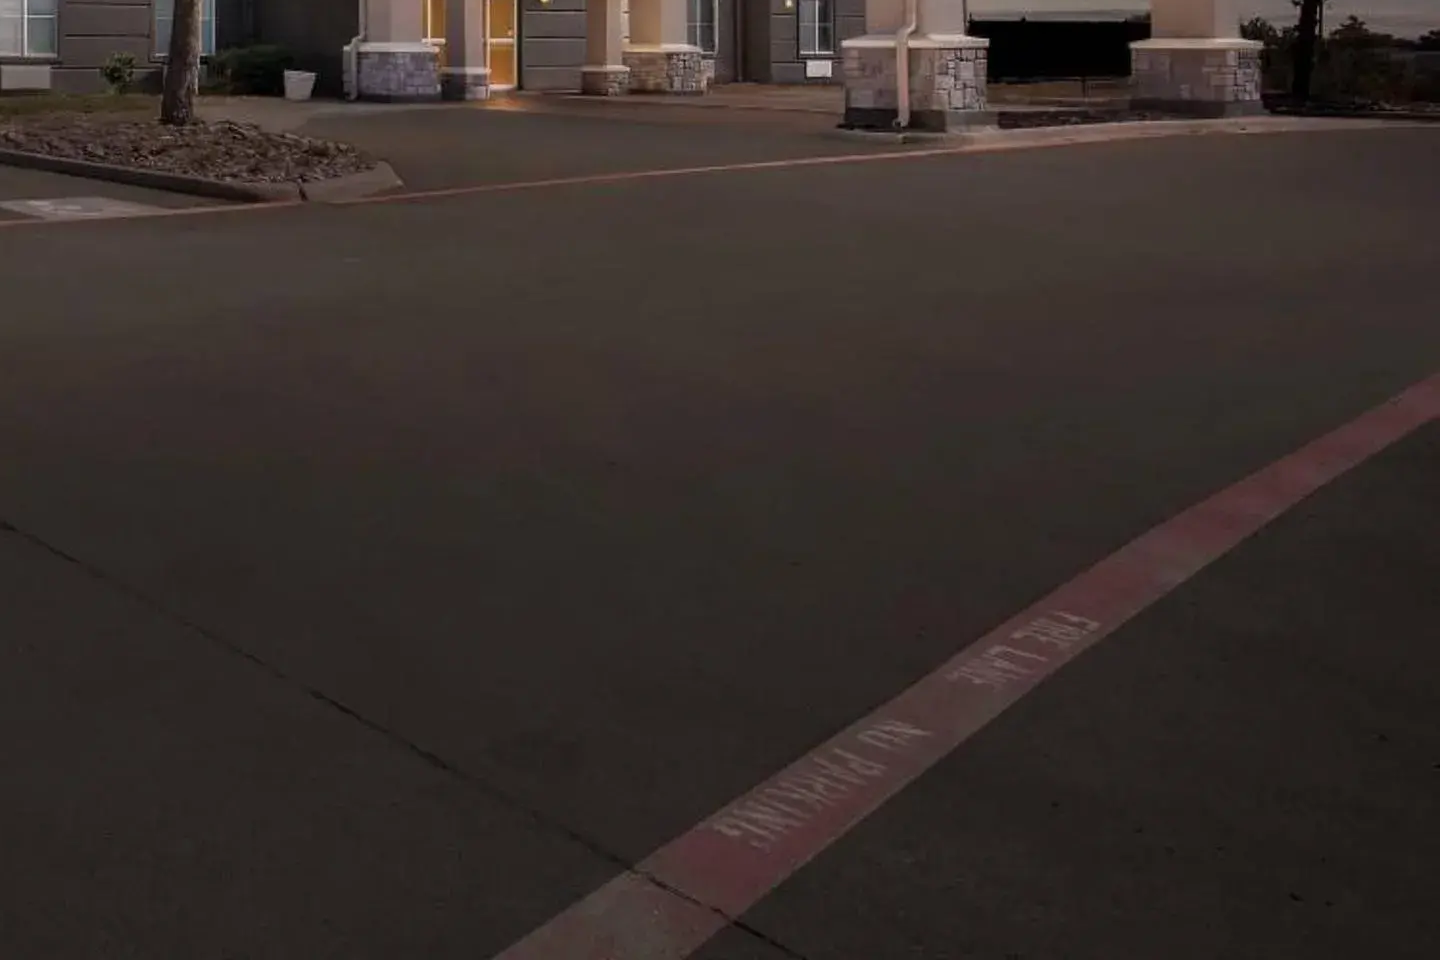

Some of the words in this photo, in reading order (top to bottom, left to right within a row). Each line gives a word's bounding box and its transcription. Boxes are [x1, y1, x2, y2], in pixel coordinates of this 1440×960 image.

[1010, 610, 1100, 649] FIRE
[945, 644, 1049, 690] LANE
[857, 719, 934, 751] NO
[713, 747, 887, 850] PARKING
